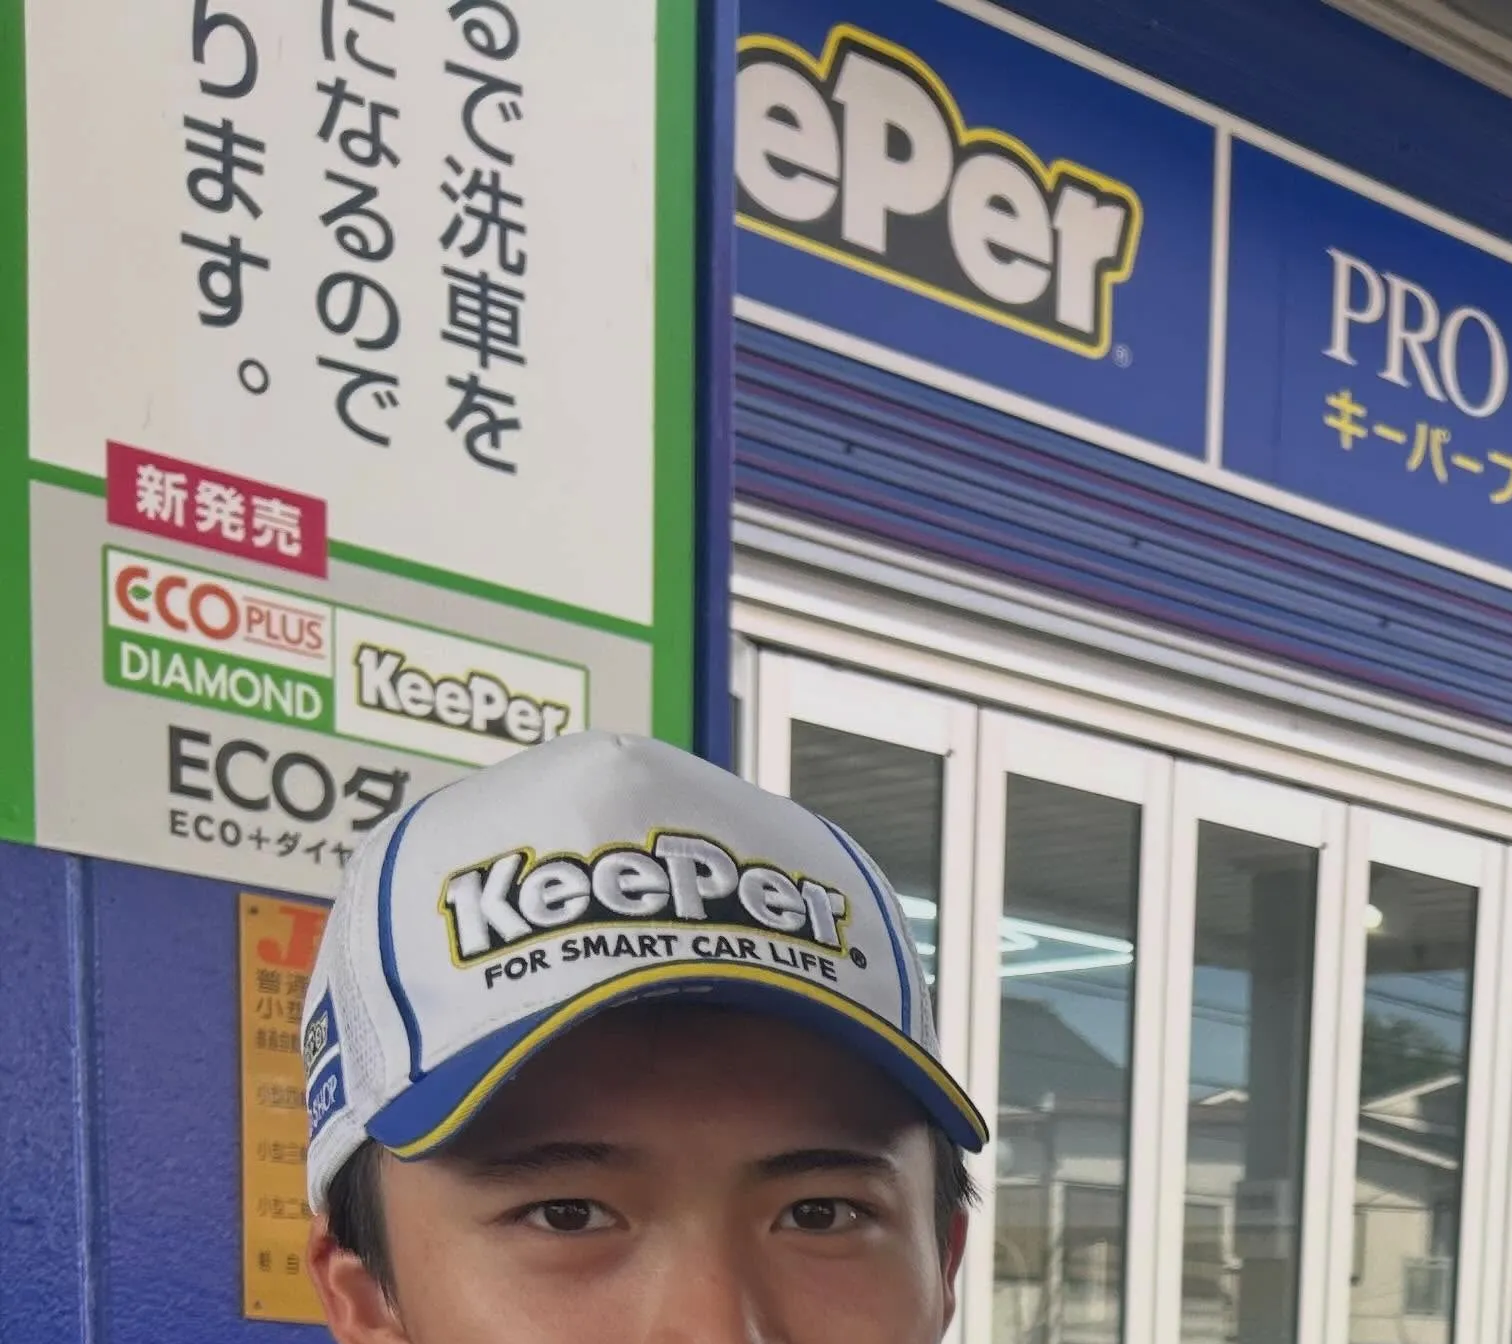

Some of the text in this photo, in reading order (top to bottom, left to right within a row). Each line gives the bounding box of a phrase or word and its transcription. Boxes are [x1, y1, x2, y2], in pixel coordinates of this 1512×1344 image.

[314, 0, 400, 447] になるので
[1322, 246, 1509, 418] PRO
[135, 462, 303, 556] 新発売
[245, 603, 324, 652] PLUS
[120, 641, 323, 723] DIAMOND
[356, 641, 570, 746] KeePer
[440, 830, 850, 967] KeePer
[484, 933, 838, 989] FOR SMART CAR LIFE
